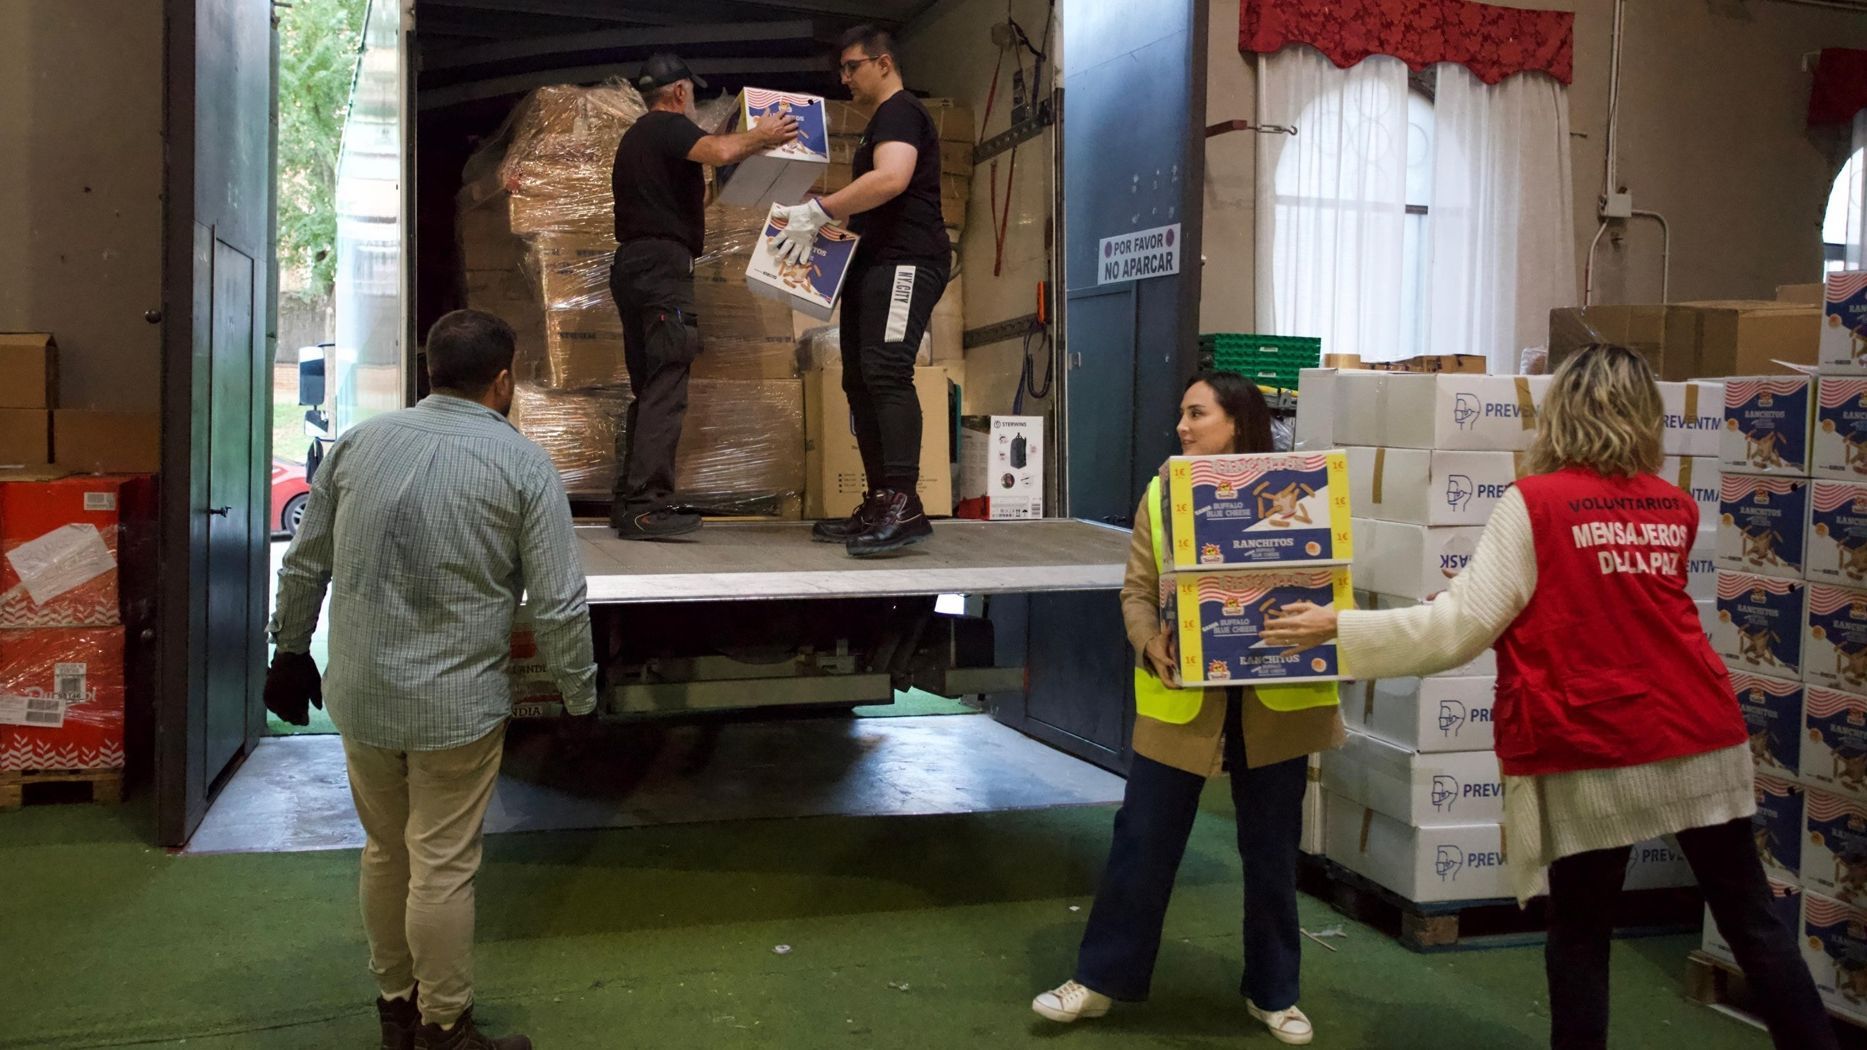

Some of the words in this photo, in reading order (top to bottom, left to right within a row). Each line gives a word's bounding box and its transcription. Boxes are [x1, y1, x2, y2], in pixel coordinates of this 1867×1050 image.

[1114, 239, 1132, 255] POR
[1134, 232, 1163, 251] FAVOR
[1104, 261, 1119, 281] NO
[1122, 251, 1173, 278] APARCAR
[1332, 461, 1344, 470] 1€
[1175, 468, 1185, 477] 1€
[1335, 497, 1346, 506] 1€
[1568, 497, 1680, 512] VOLUNTARIOS
[1176, 503, 1187, 512] 1€
[1336, 533, 1348, 542] 1€
[1571, 521, 1688, 549] MENSAJEROS
[1178, 539, 1189, 548] 1€
[1233, 538, 1294, 549] RANCHITOS
[1650, 552, 1680, 575] PAZ
[1338, 577, 1349, 586] 1€
[1182, 584, 1192, 593] 1€
[1184, 620, 1195, 629] 1€
[1185, 656, 1196, 664] 1€
[1240, 655, 1300, 665] RANCHITOS
[1467, 852, 1508, 867] PREV
